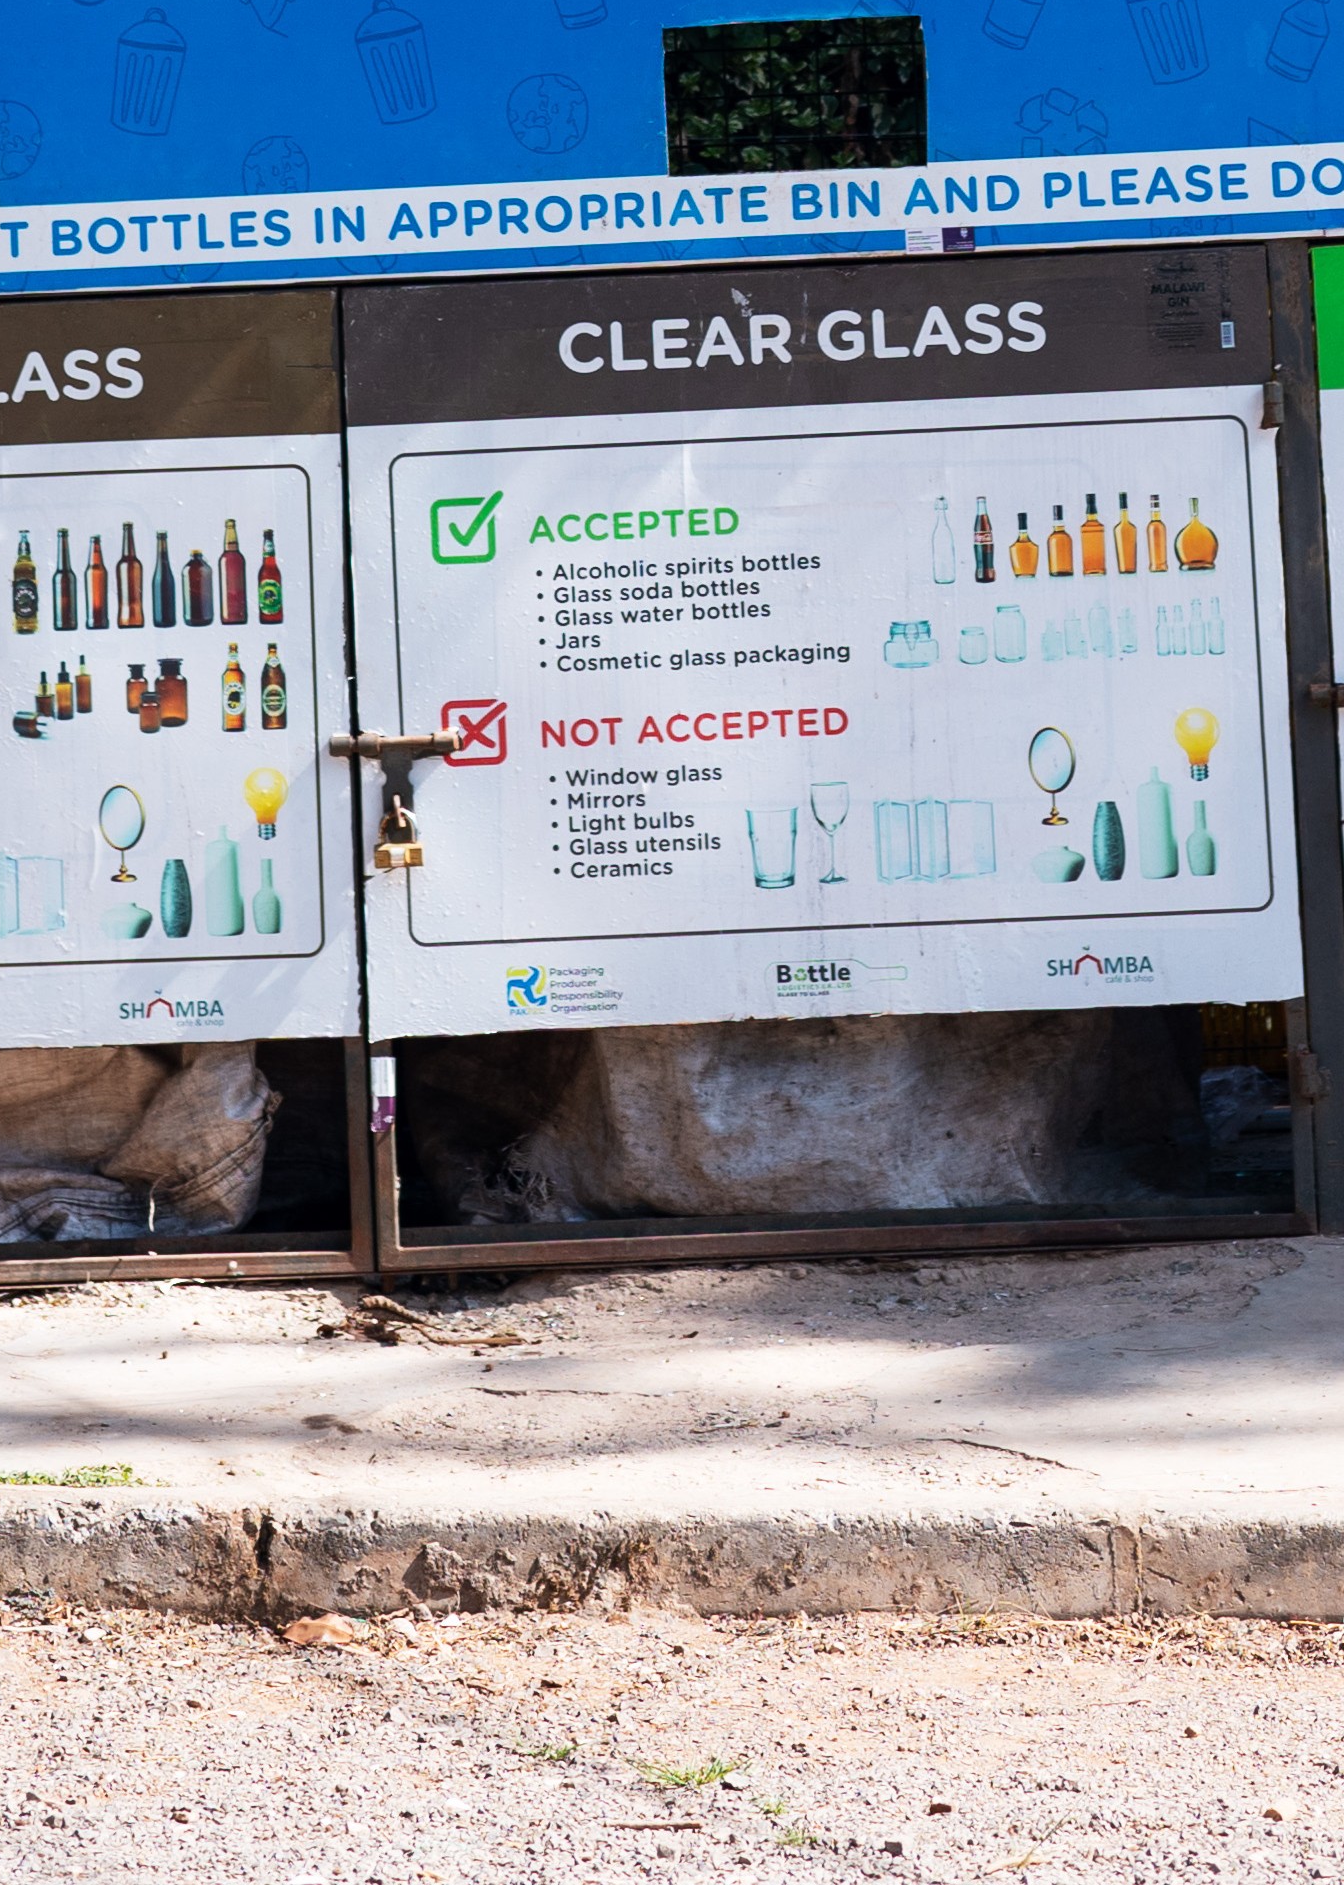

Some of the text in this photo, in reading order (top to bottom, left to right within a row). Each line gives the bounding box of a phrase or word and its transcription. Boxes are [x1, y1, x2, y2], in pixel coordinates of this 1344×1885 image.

[51, 208, 292, 257] BOTTLES
[315, 204, 367, 244] IN
[387, 182, 768, 239] APPROPRIATE
[792, 178, 881, 219] BIN
[904, 174, 1020, 216] AND
[1044, 161, 1248, 210] PLEASE
[1151, 282, 1206, 294] MALAWI
[1168, 297, 1189, 307] GIN
[559, 301, 1047, 373] CLEAR GLASS
[529, 507, 739, 544] ACCEPTED
[552, 554, 820, 581] Alcoholic spirits bottles
[553, 579, 760, 604] Glass soda bottles
[554, 601, 771, 627] Glass water bottles
[555, 631, 601, 650] Jars
[557, 643, 851, 673] Cosmetic glass packaging
[541, 707, 849, 749] NOT ACCEPTED
[566, 763, 723, 786] Window glass
[566, 791, 646, 810] Mirrors
[568, 811, 695, 834] Light bulbs
[569, 833, 721, 856] Glass utensils
[570, 859, 673, 879] Ceramics
[1047, 953, 1153, 977] SHAMBA
[120, 998, 224, 1019] SHAMBA
